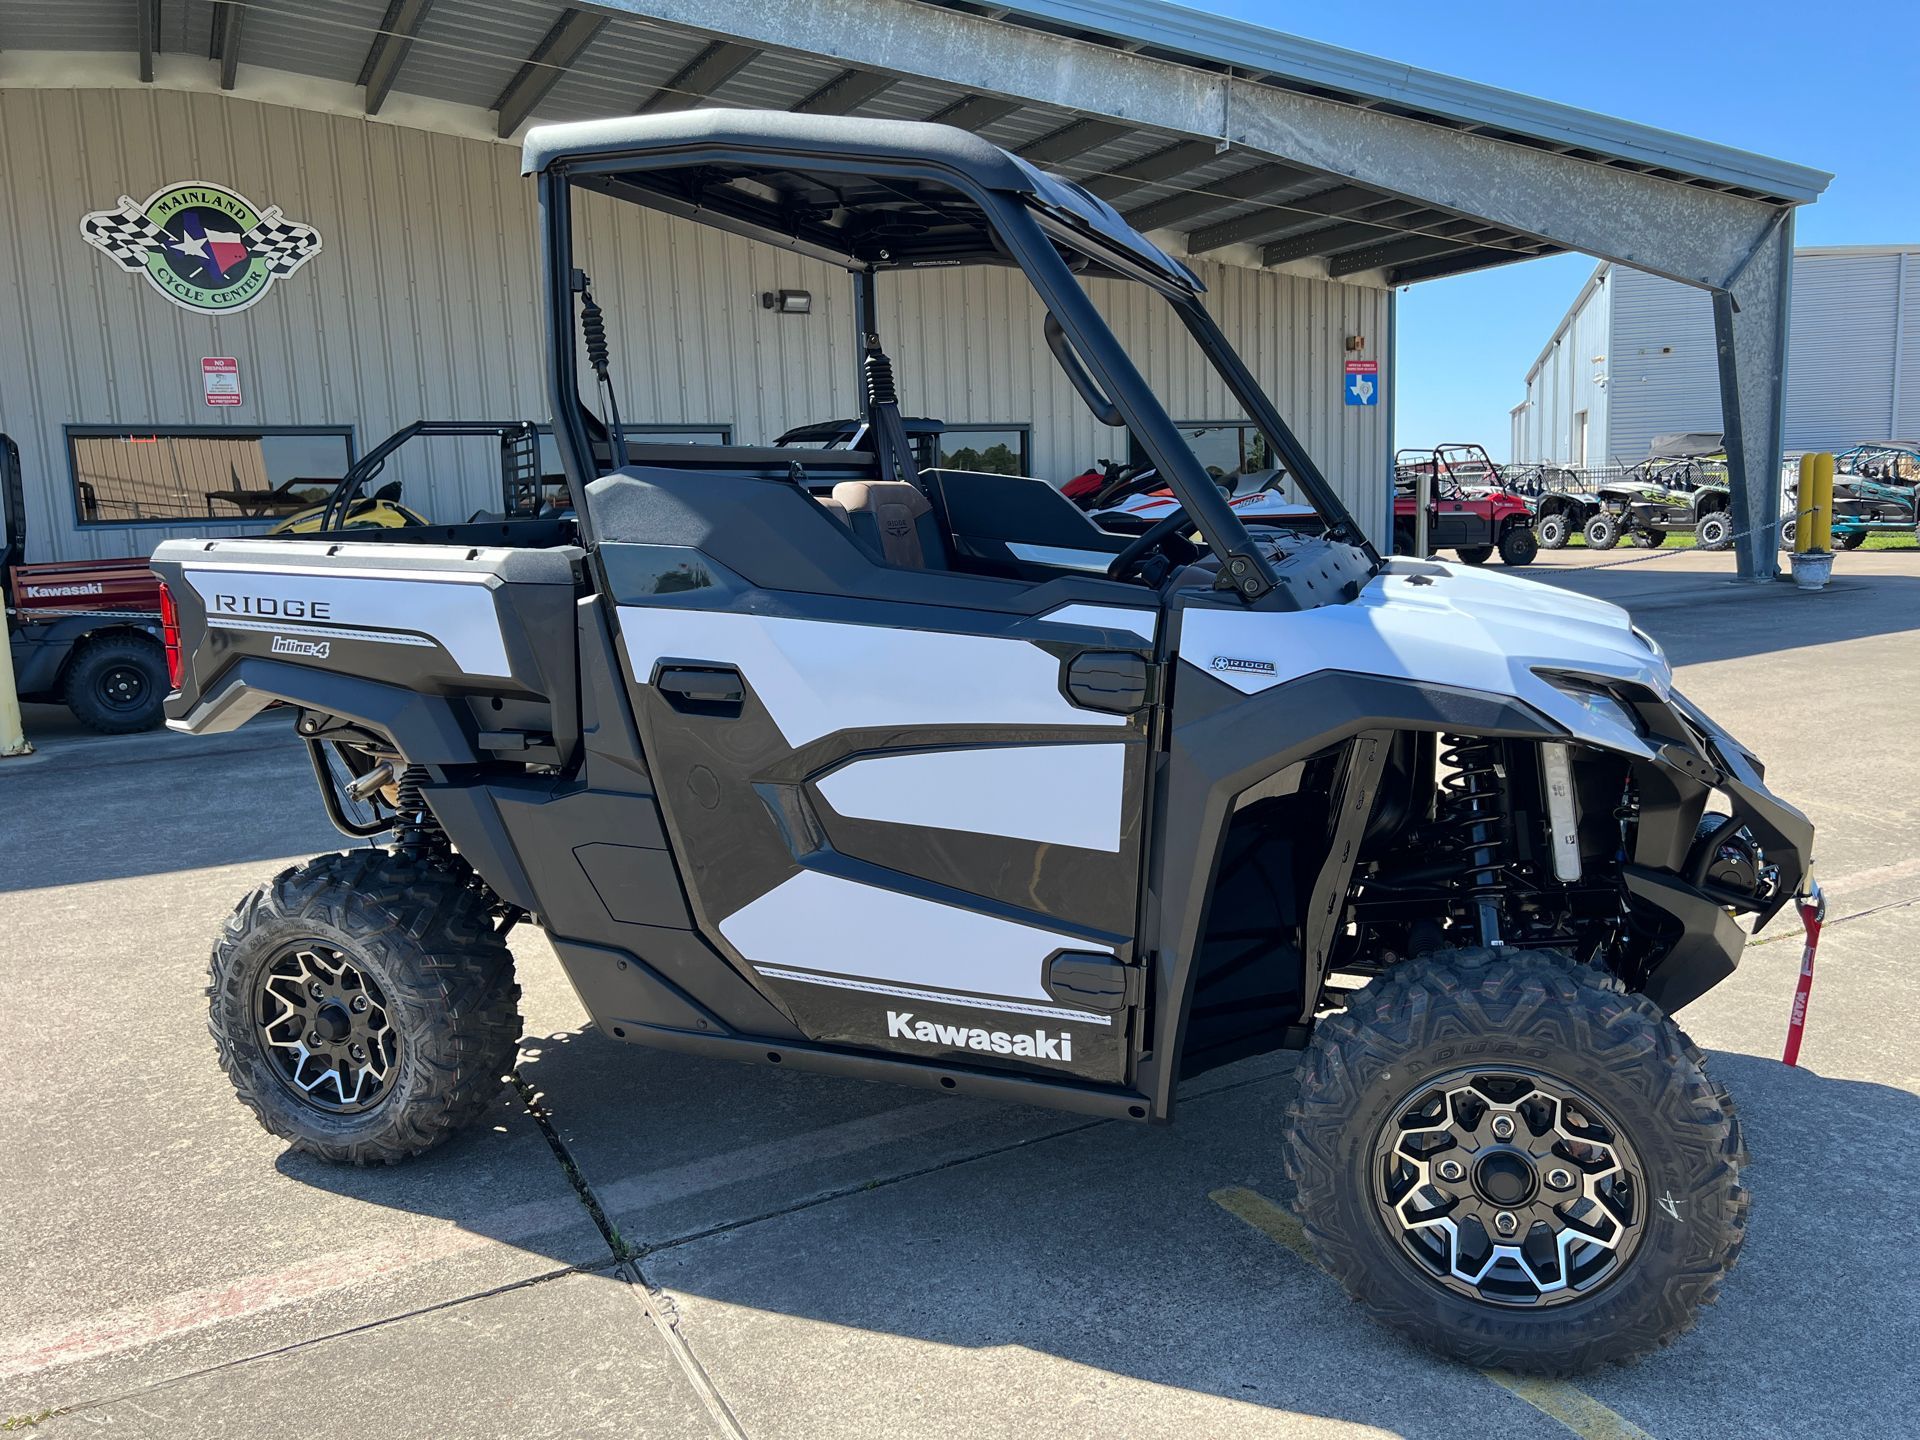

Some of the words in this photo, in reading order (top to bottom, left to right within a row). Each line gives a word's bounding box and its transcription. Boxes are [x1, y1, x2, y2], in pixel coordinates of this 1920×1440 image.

[157, 192, 246, 220] MAINLAND
[157, 267, 204, 302] CYCLE
[211, 271, 262, 304] CENTER
[27, 582, 103, 598] Kawasaki
[215, 594, 331, 620] RIDGE
[272, 636, 330, 659] Inline-4
[1230, 660, 1273, 670] RIDGE
[1791, 991, 1807, 1027] WARN
[886, 1010, 1072, 1062] Kawasaki
